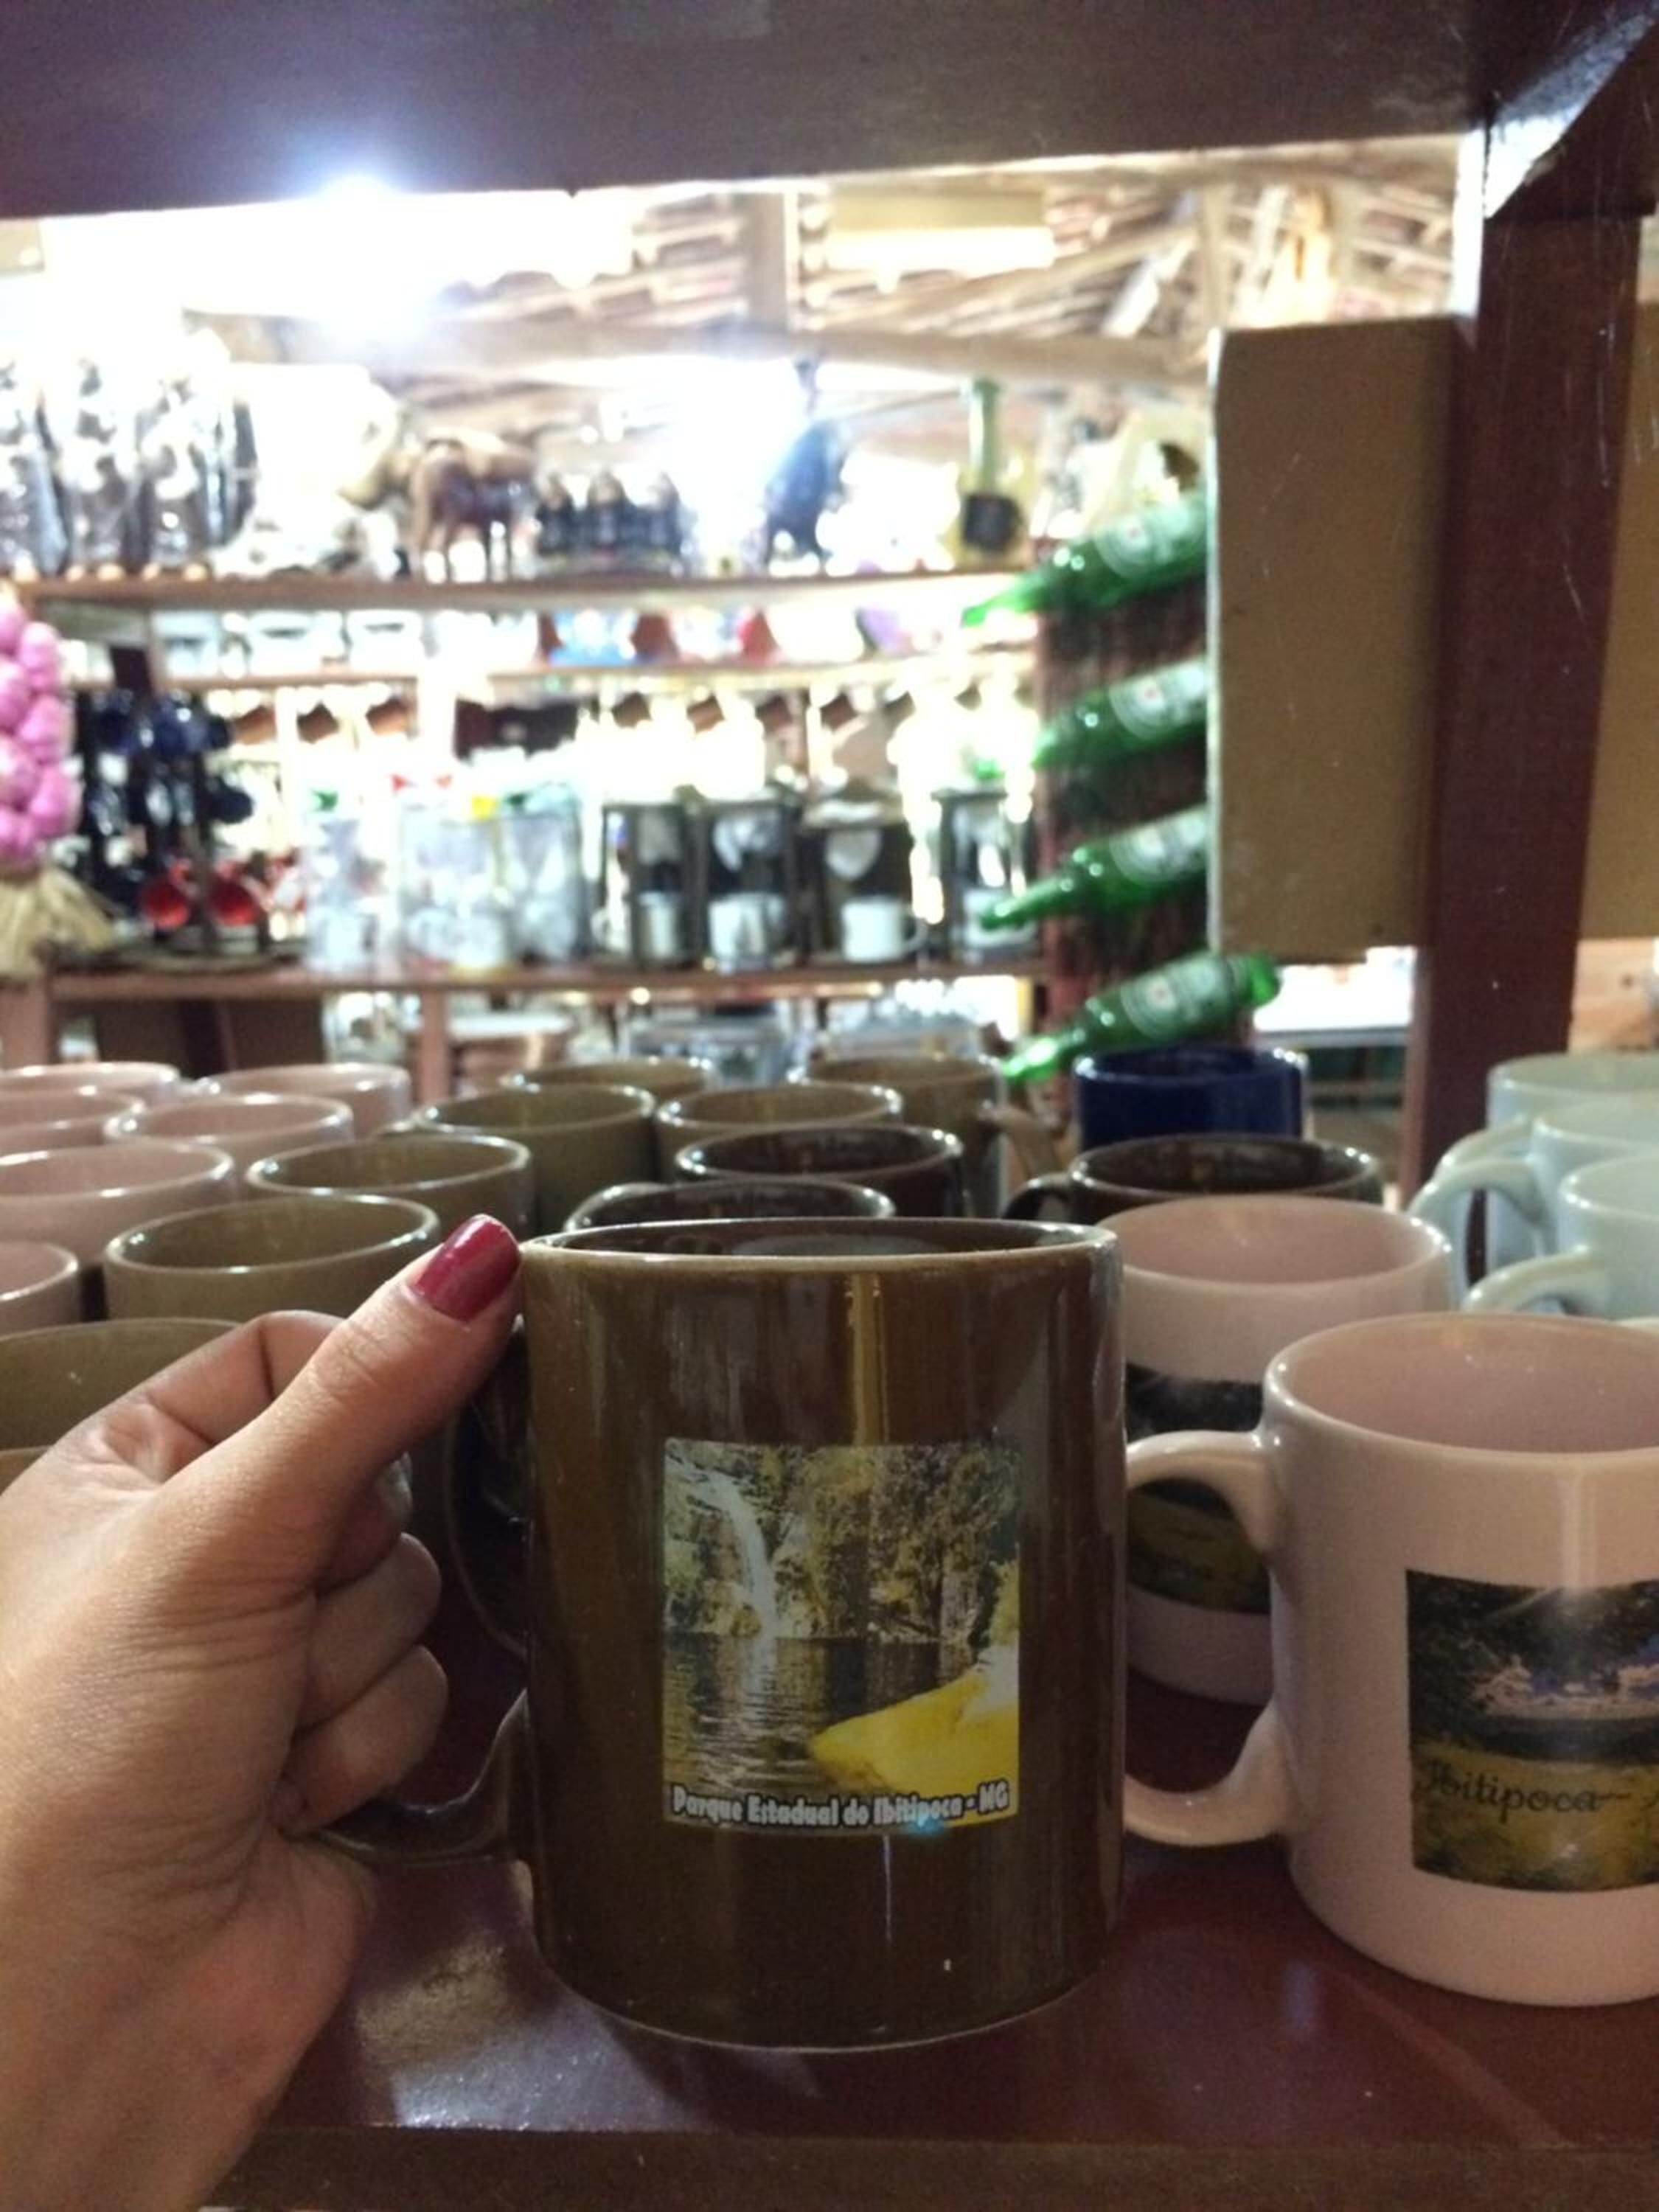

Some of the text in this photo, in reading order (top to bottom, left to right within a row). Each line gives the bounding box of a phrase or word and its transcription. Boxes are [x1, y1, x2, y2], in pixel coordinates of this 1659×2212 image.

[672, 1784, 743, 1823] Parque
[747, 1794, 840, 1826] Estadual
[842, 1796, 870, 1826] do
[978, 1781, 1009, 1814] MG
